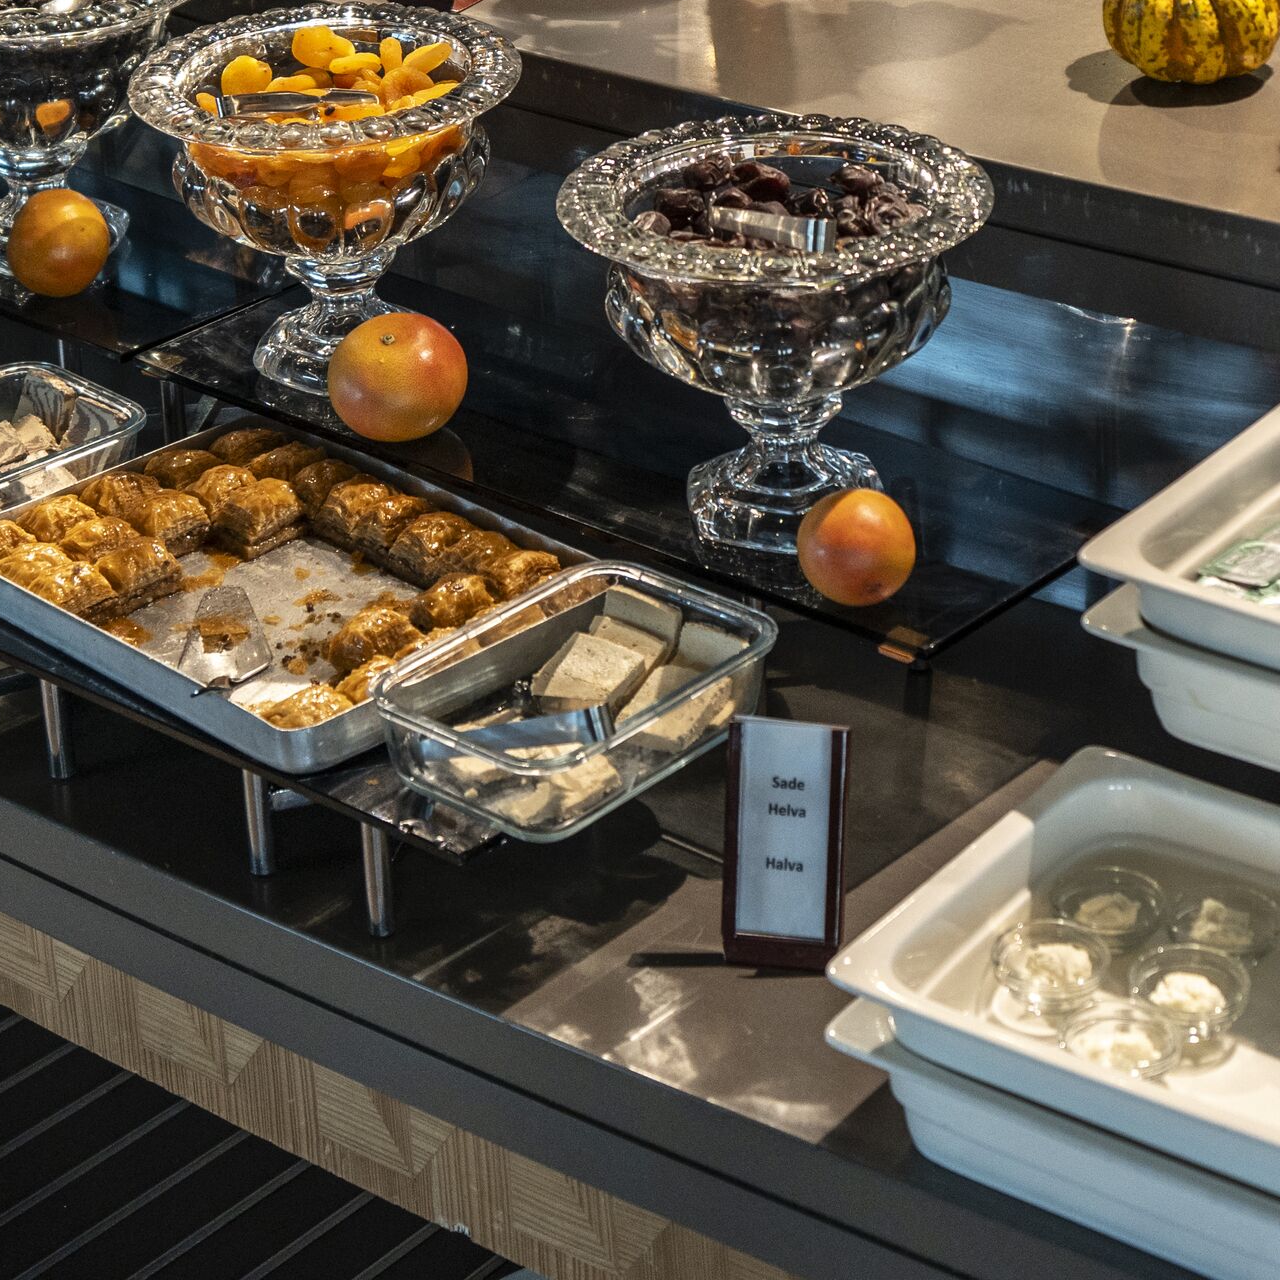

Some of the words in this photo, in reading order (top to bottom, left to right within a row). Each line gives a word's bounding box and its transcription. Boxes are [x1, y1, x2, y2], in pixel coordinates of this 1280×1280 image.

[771, 776, 805, 792] Sade
[768, 803, 807, 819] Helva
[766, 857, 804, 873] Halva
